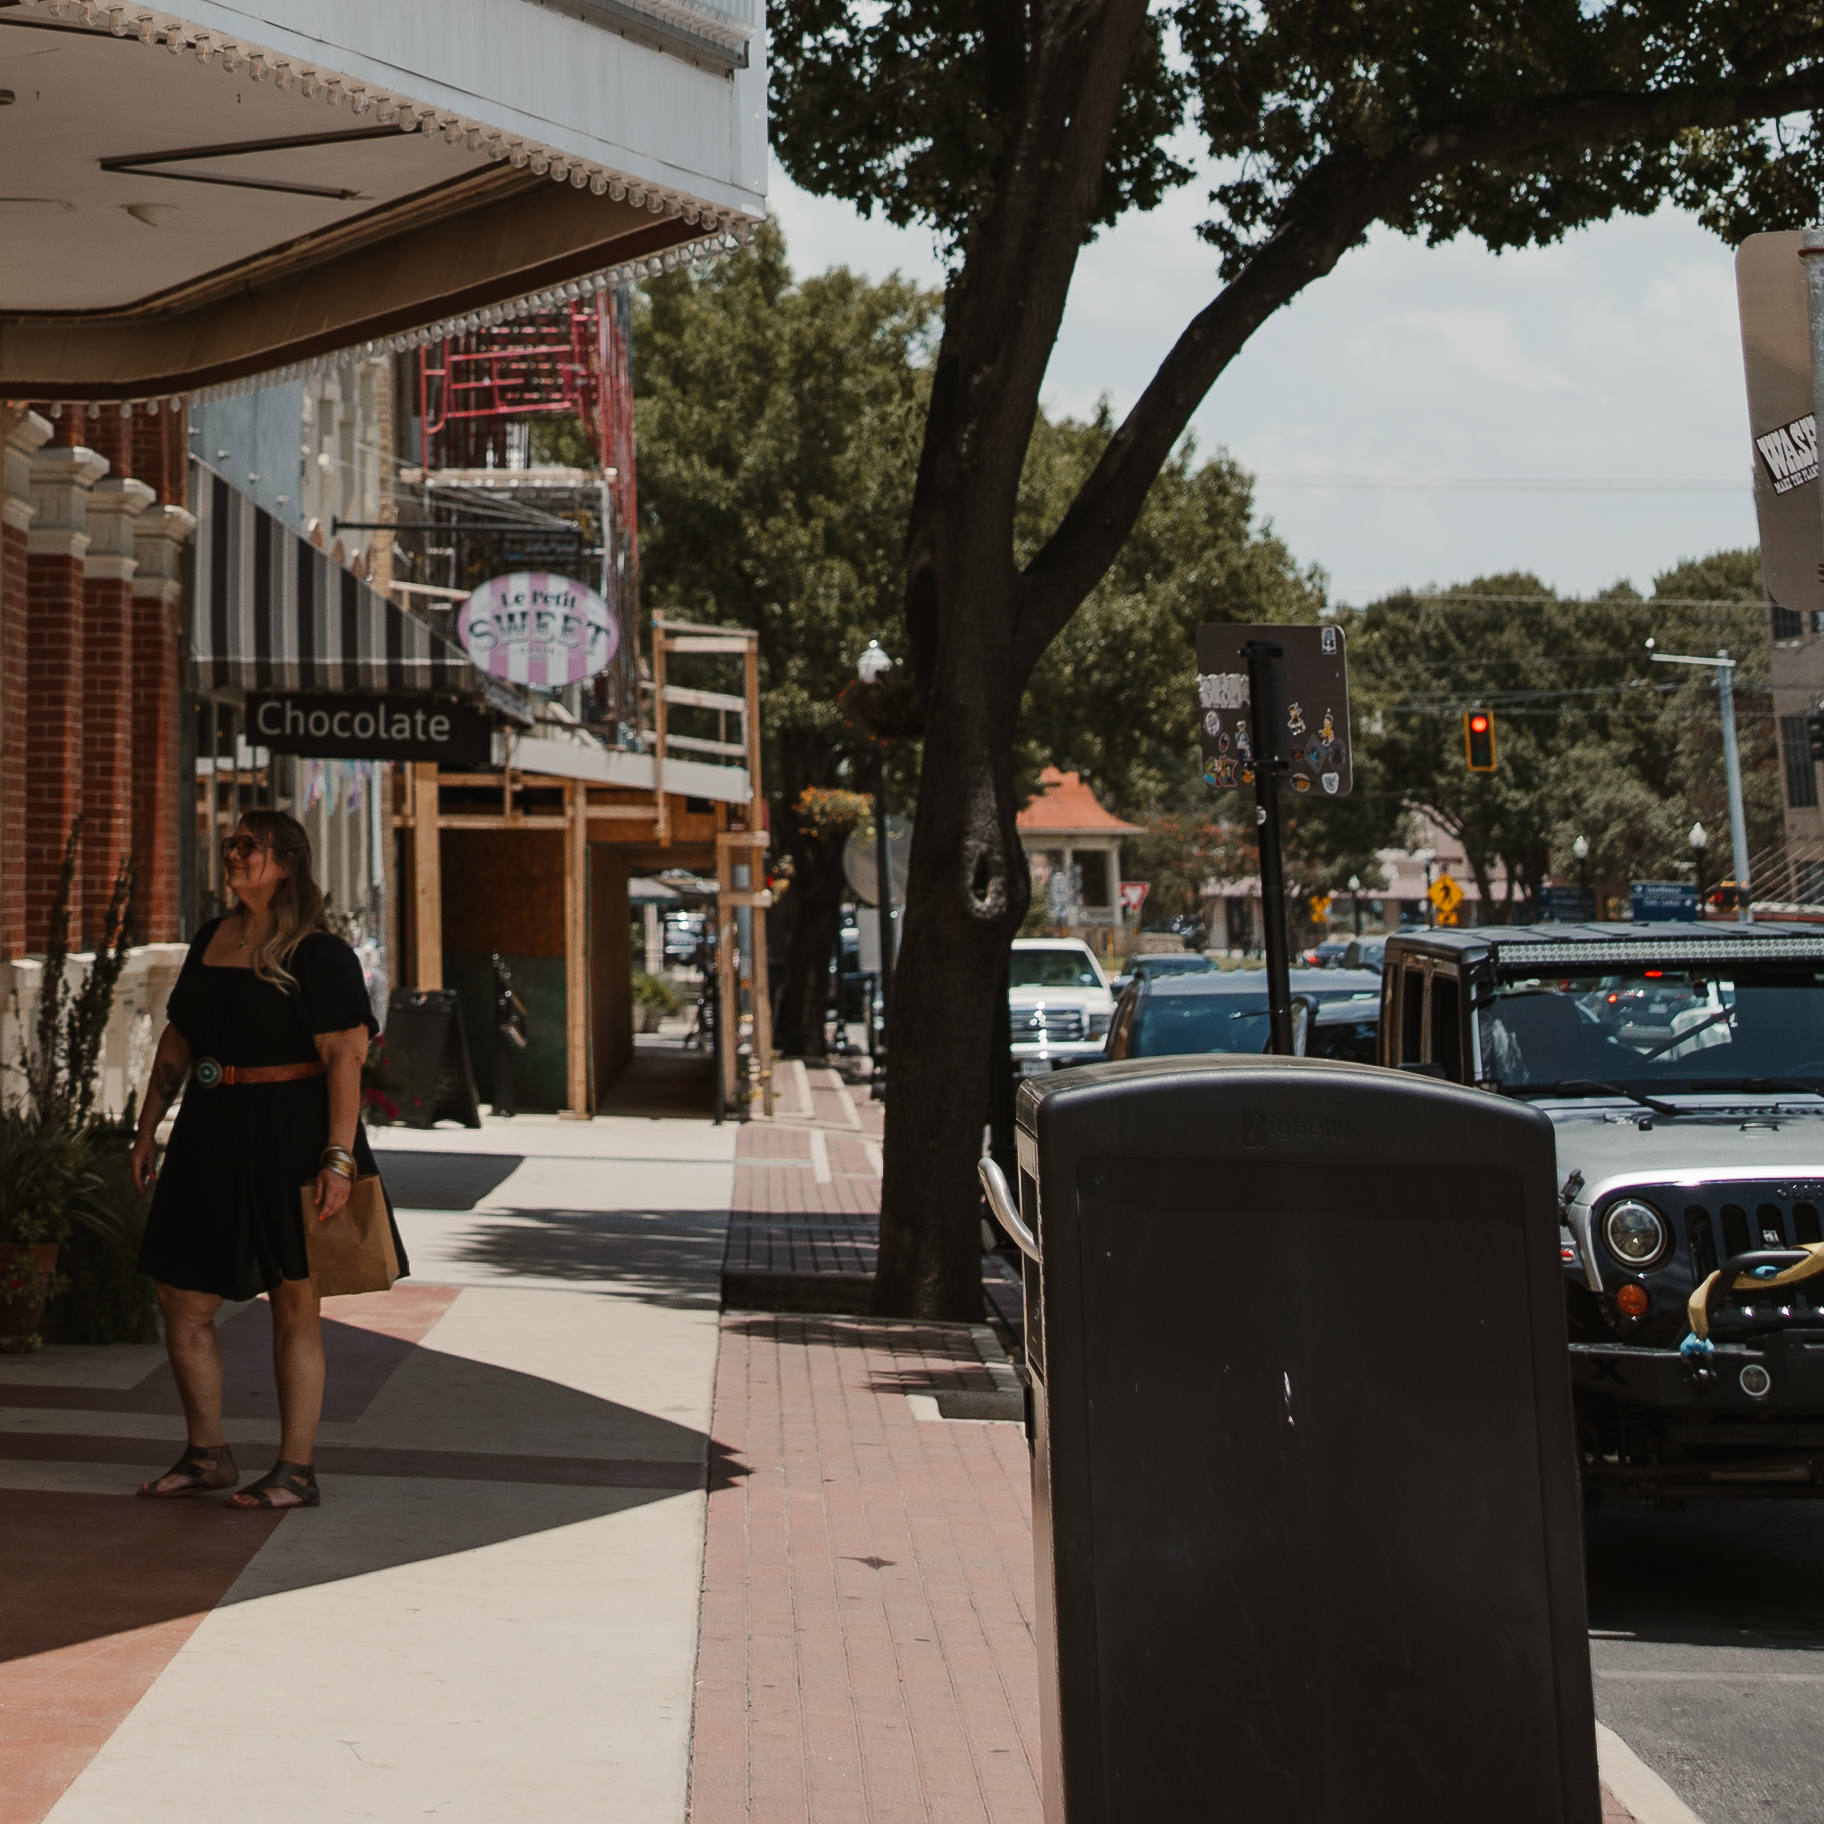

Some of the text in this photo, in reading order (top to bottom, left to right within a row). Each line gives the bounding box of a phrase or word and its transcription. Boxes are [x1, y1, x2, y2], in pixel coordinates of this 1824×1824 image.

[501, 589, 577, 608] Le Petit
[468, 609, 611, 656] SWEET
[257, 701, 450, 742] Chocolate
